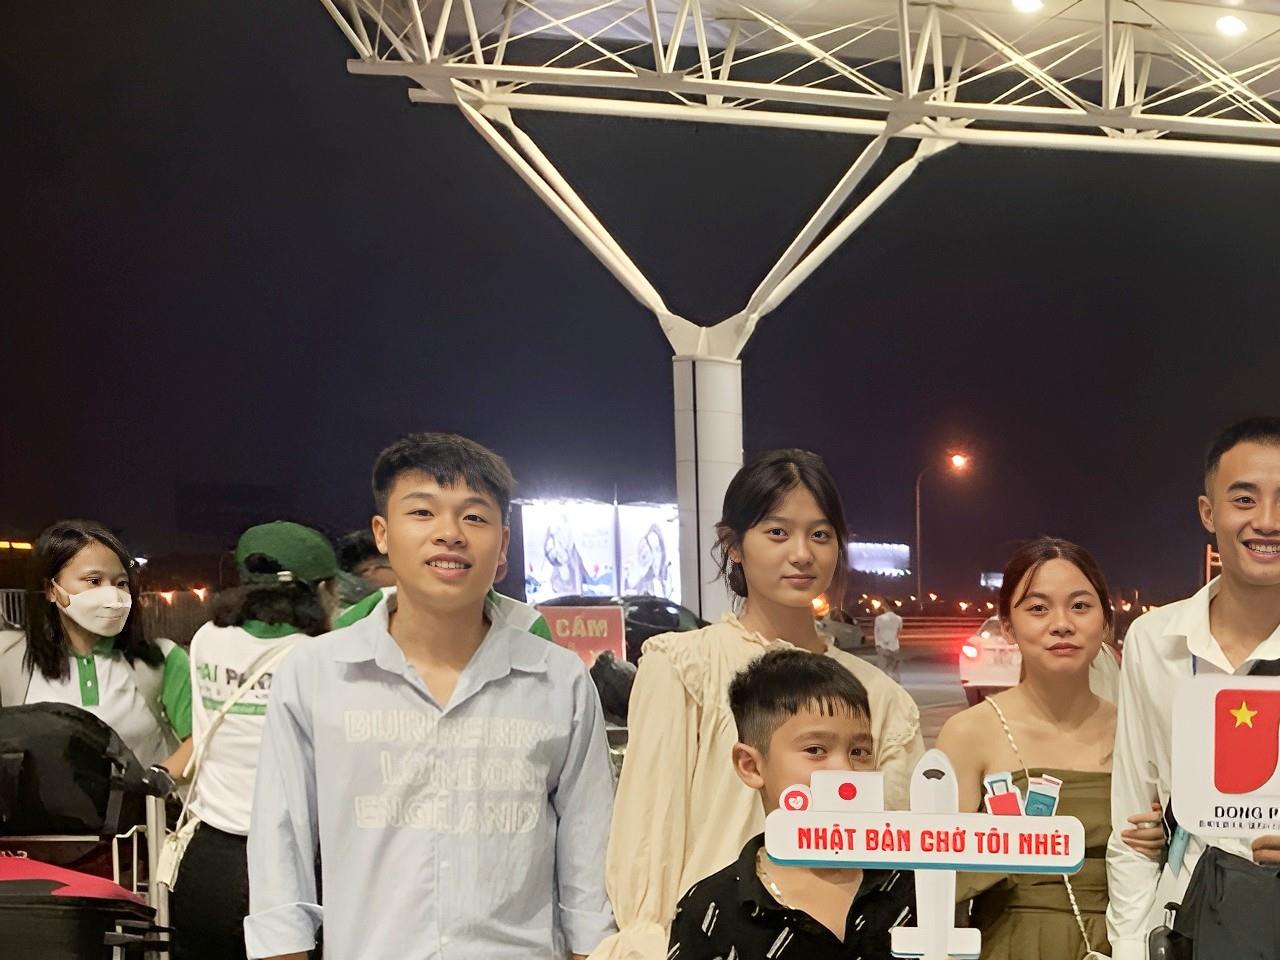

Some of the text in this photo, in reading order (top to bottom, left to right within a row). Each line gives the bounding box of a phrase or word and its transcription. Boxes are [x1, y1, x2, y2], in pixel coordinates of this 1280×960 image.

[354, 792, 541, 834] ENGLAND
[798, 823, 857, 855] NHẬT
[865, 822, 911, 852] BẢN
[974, 828, 1009, 854] TÔI
